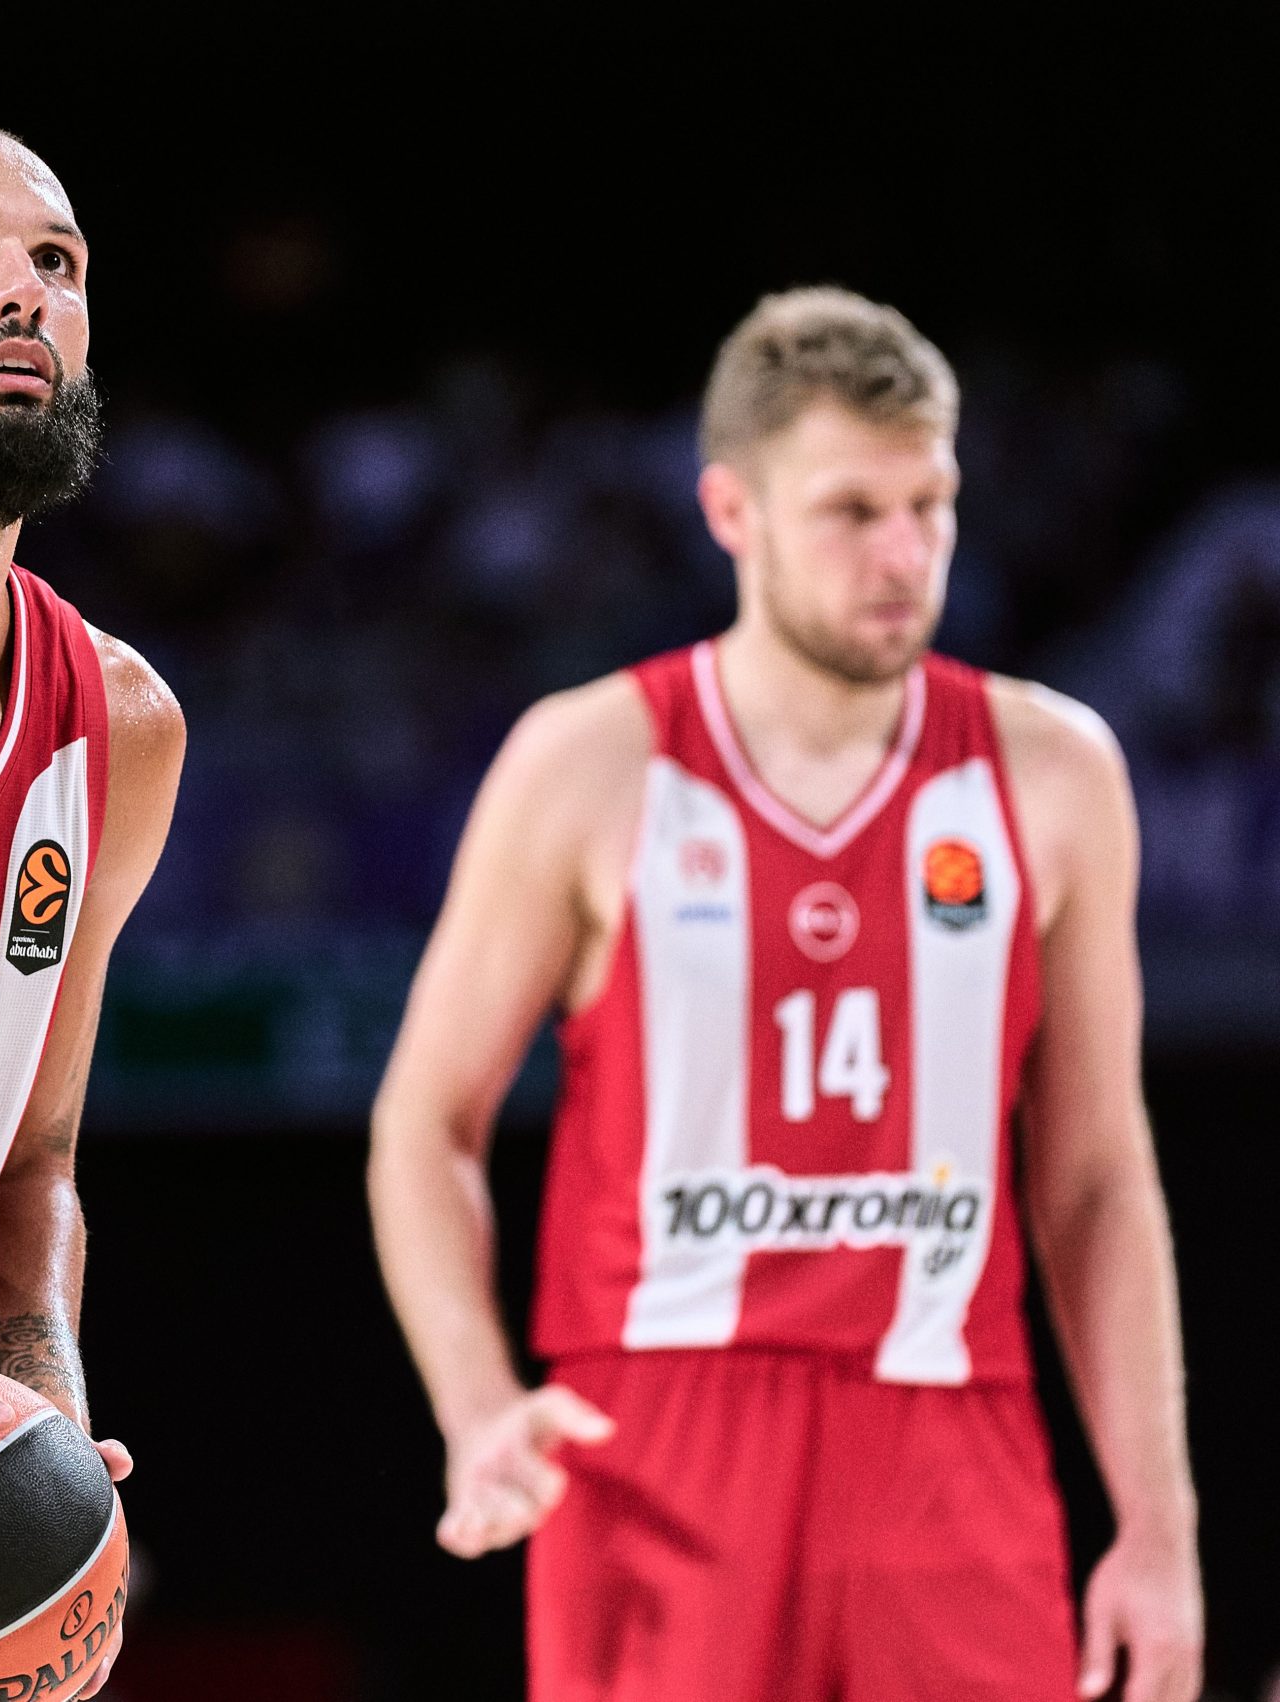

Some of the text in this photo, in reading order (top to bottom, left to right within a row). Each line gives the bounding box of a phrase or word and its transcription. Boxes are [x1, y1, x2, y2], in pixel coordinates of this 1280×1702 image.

[9, 943, 58, 960] abu dhabi
[774, 988, 889, 1122] 14
[664, 1168, 980, 1237] 100xronia
